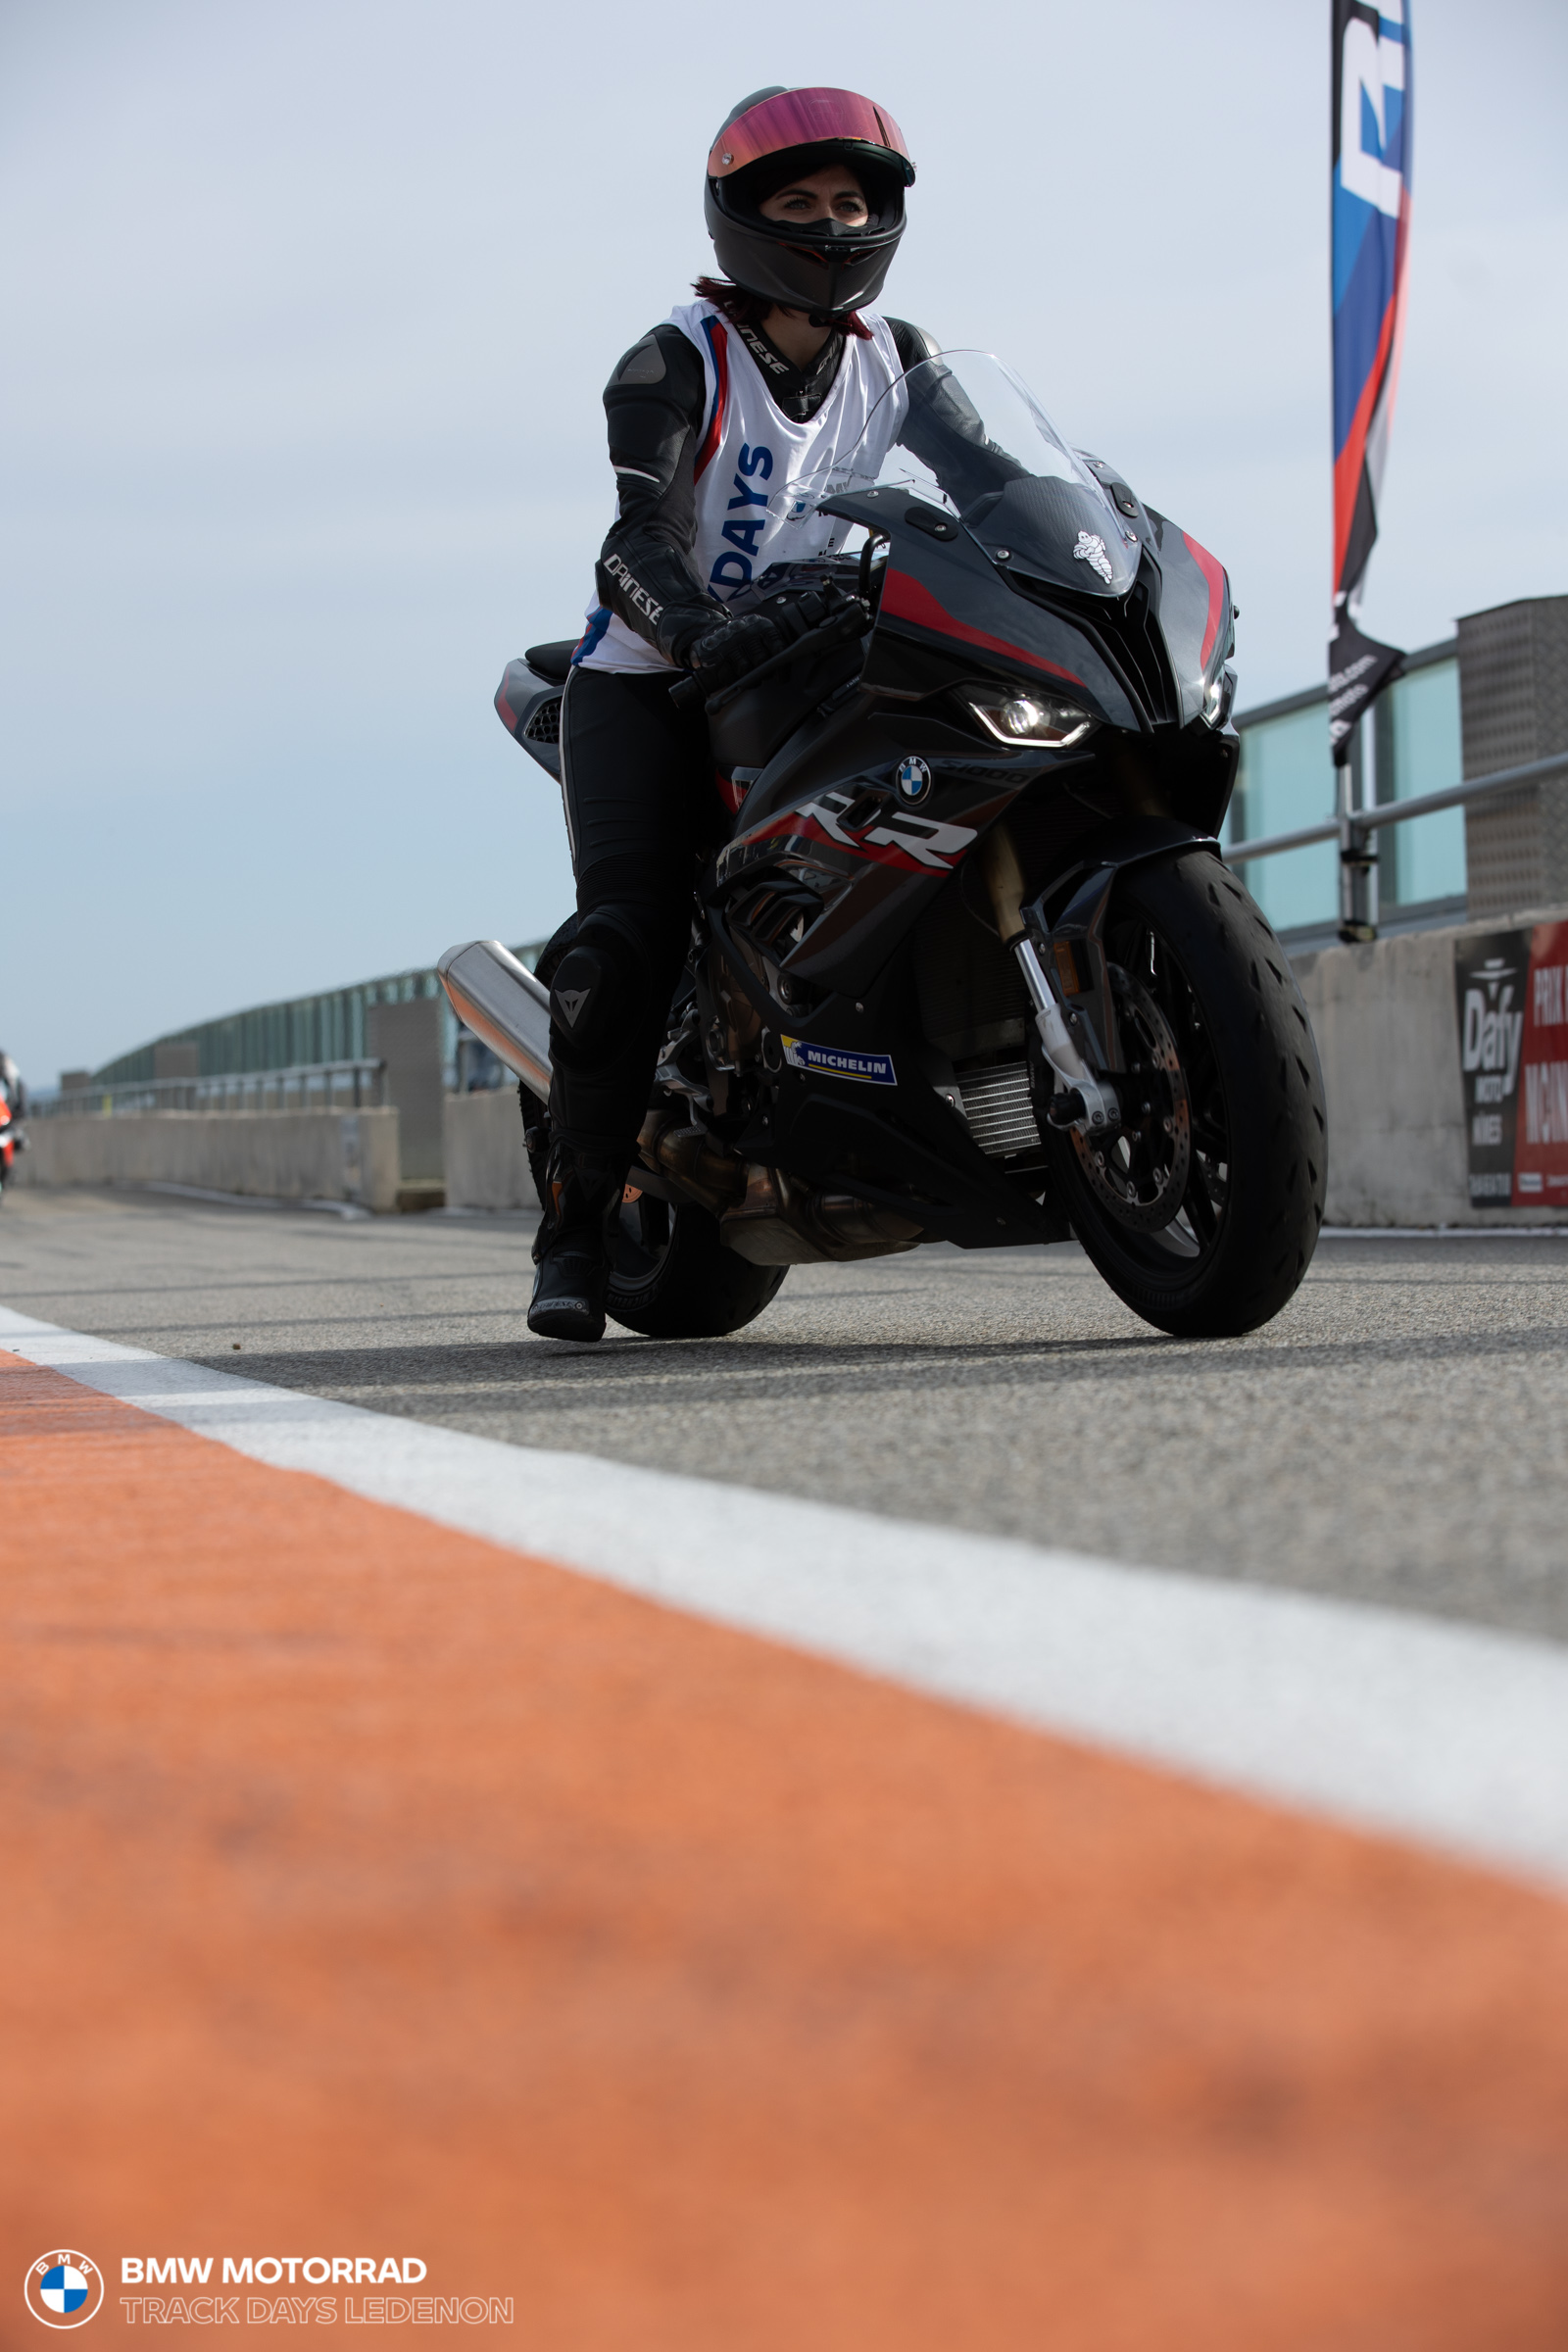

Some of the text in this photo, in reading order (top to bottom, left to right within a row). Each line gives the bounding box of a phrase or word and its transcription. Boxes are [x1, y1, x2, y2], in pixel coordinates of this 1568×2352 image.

[603, 553, 663, 626] DAINESE
[935, 760, 1028, 784] S1000
[793, 792, 978, 869] RR
[1534, 965, 1564, 1027] PRIX
[808, 1050, 887, 1074] MICHELIN
[1462, 985, 1524, 1096] Dafy
